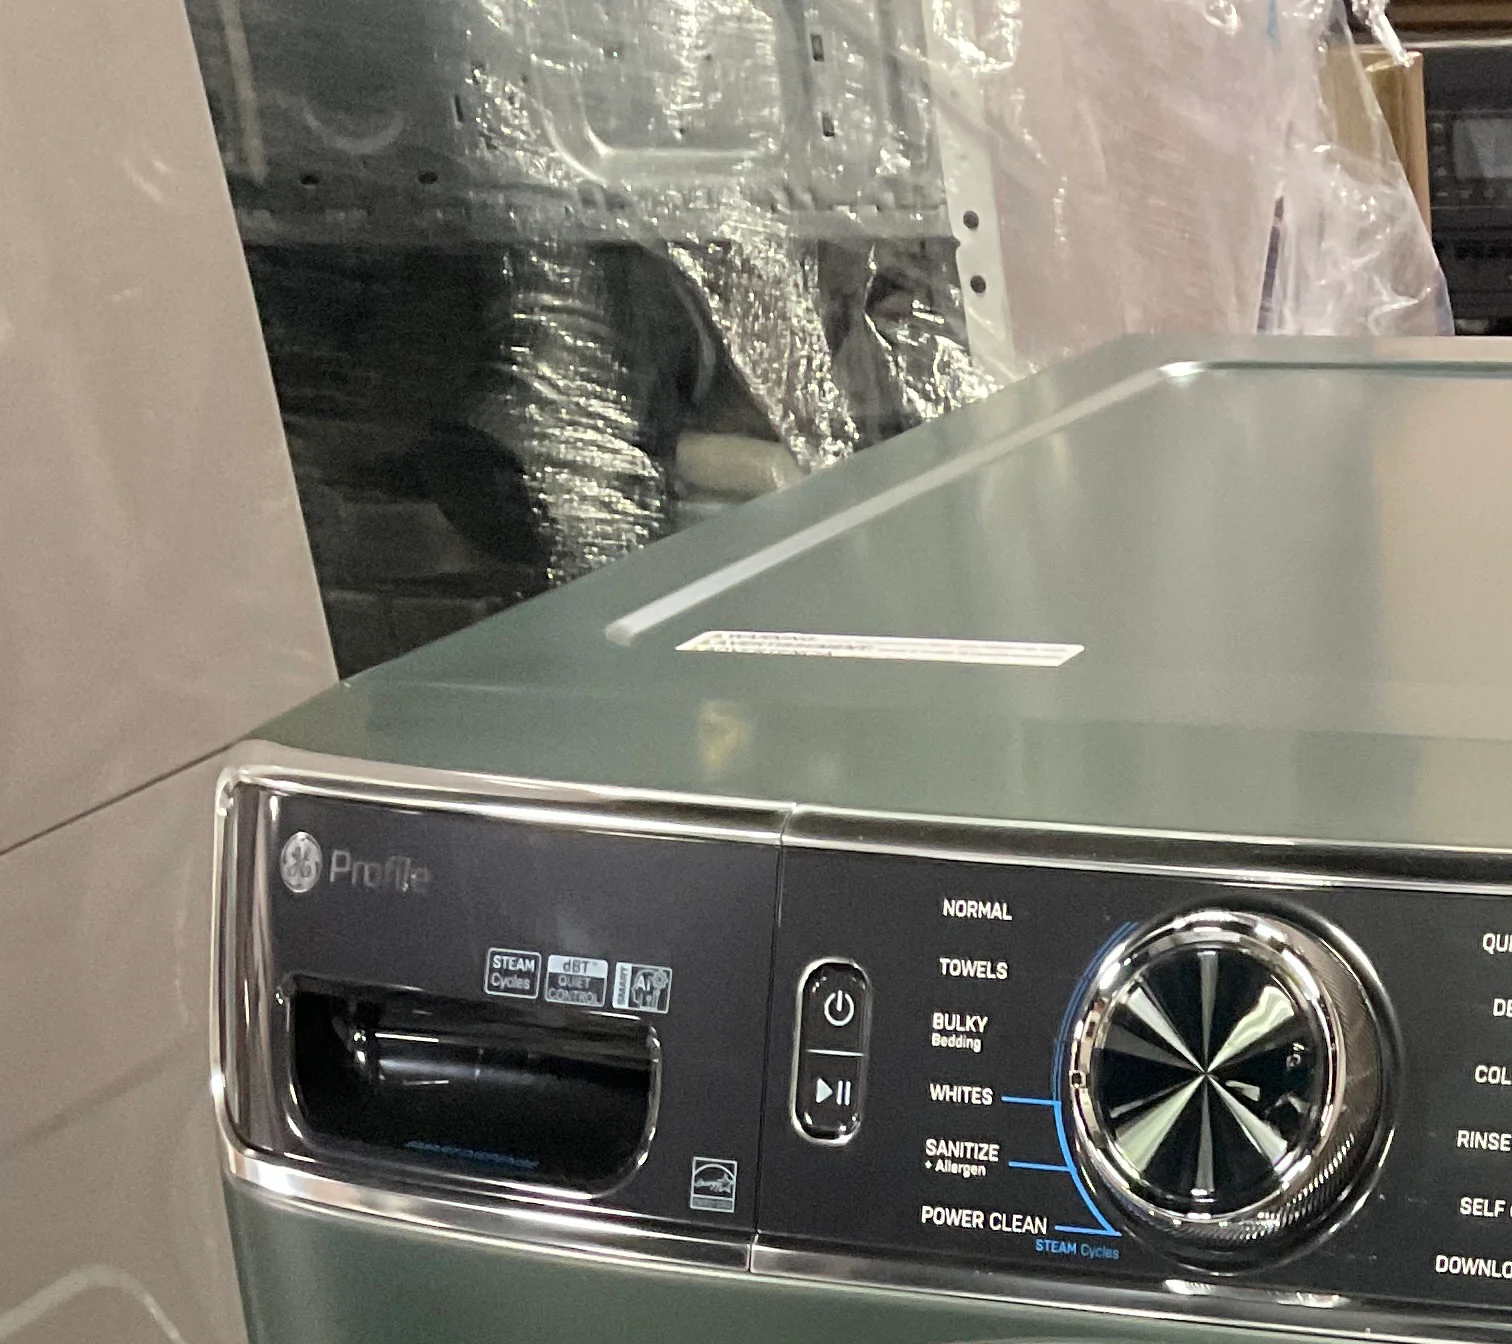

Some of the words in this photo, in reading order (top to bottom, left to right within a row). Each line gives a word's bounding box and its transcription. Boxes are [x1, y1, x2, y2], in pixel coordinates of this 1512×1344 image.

[942, 898, 1013, 921] NORMAL
[492, 955, 535, 973] STEAM
[939, 957, 1009, 980] TOWELS
[491, 972, 531, 991] Cycles
[557, 976, 591, 989] QUIET
[548, 988, 598, 1004] CONTROL
[932, 1012, 989, 1034] BULKY
[931, 1033, 982, 1053] Bedding
[929, 1083, 994, 1106] WHITES
[924, 1138, 1000, 1163] SANITIZE
[1456, 1130, 1512, 1153] RINSE
[934, 1160, 987, 1178] Allergen
[1459, 1196, 1506, 1219] SELF
[921, 1205, 985, 1230] POWER
[989, 1212, 1048, 1235] CLEAN
[1035, 1238, 1077, 1255] STEAM
[1080, 1243, 1120, 1260] Cycles
